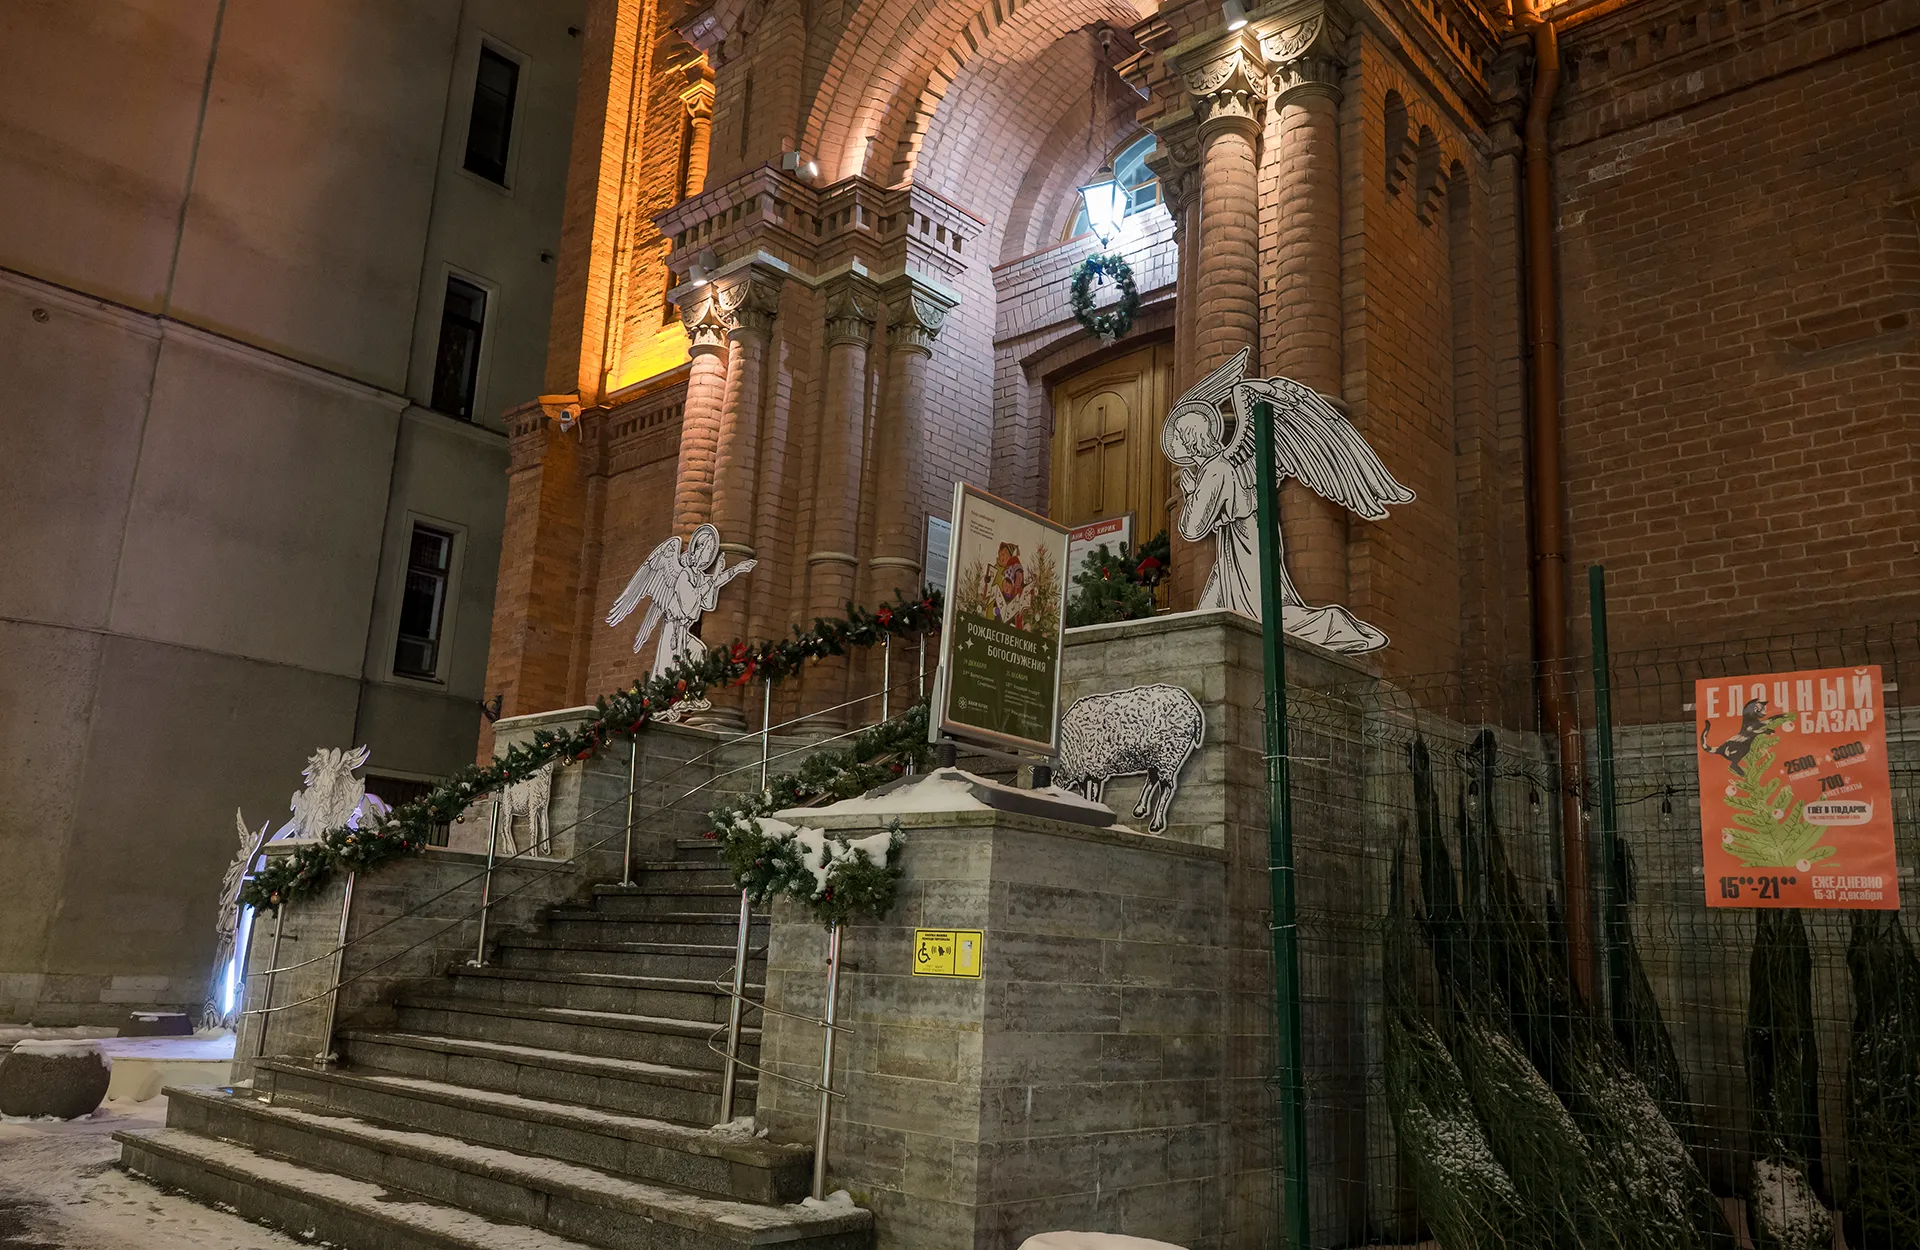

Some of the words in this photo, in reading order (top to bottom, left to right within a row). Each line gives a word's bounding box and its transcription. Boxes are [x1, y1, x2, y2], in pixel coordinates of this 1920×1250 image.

[967, 622, 1038, 654] РОЖДЕСТВЕНСКИЕ
[987, 645, 1046, 673] БОГОСЛУЖЕНИЯ
[1706, 668, 1873, 718] ЕЛОЧНЫЙ
[1800, 708, 1874, 734] БАЗАР
[1831, 741, 1864, 761] 3000
[1784, 754, 1816, 774] 2500
[1817, 774, 1844, 792] 700
[1831, 805, 1867, 815] ПОДАРОК
[1811, 875, 1883, 890] ЕЖЕДНЕВНО
[1812, 889, 1836, 900] 15-31
[1838, 889, 1883, 902] декабря
